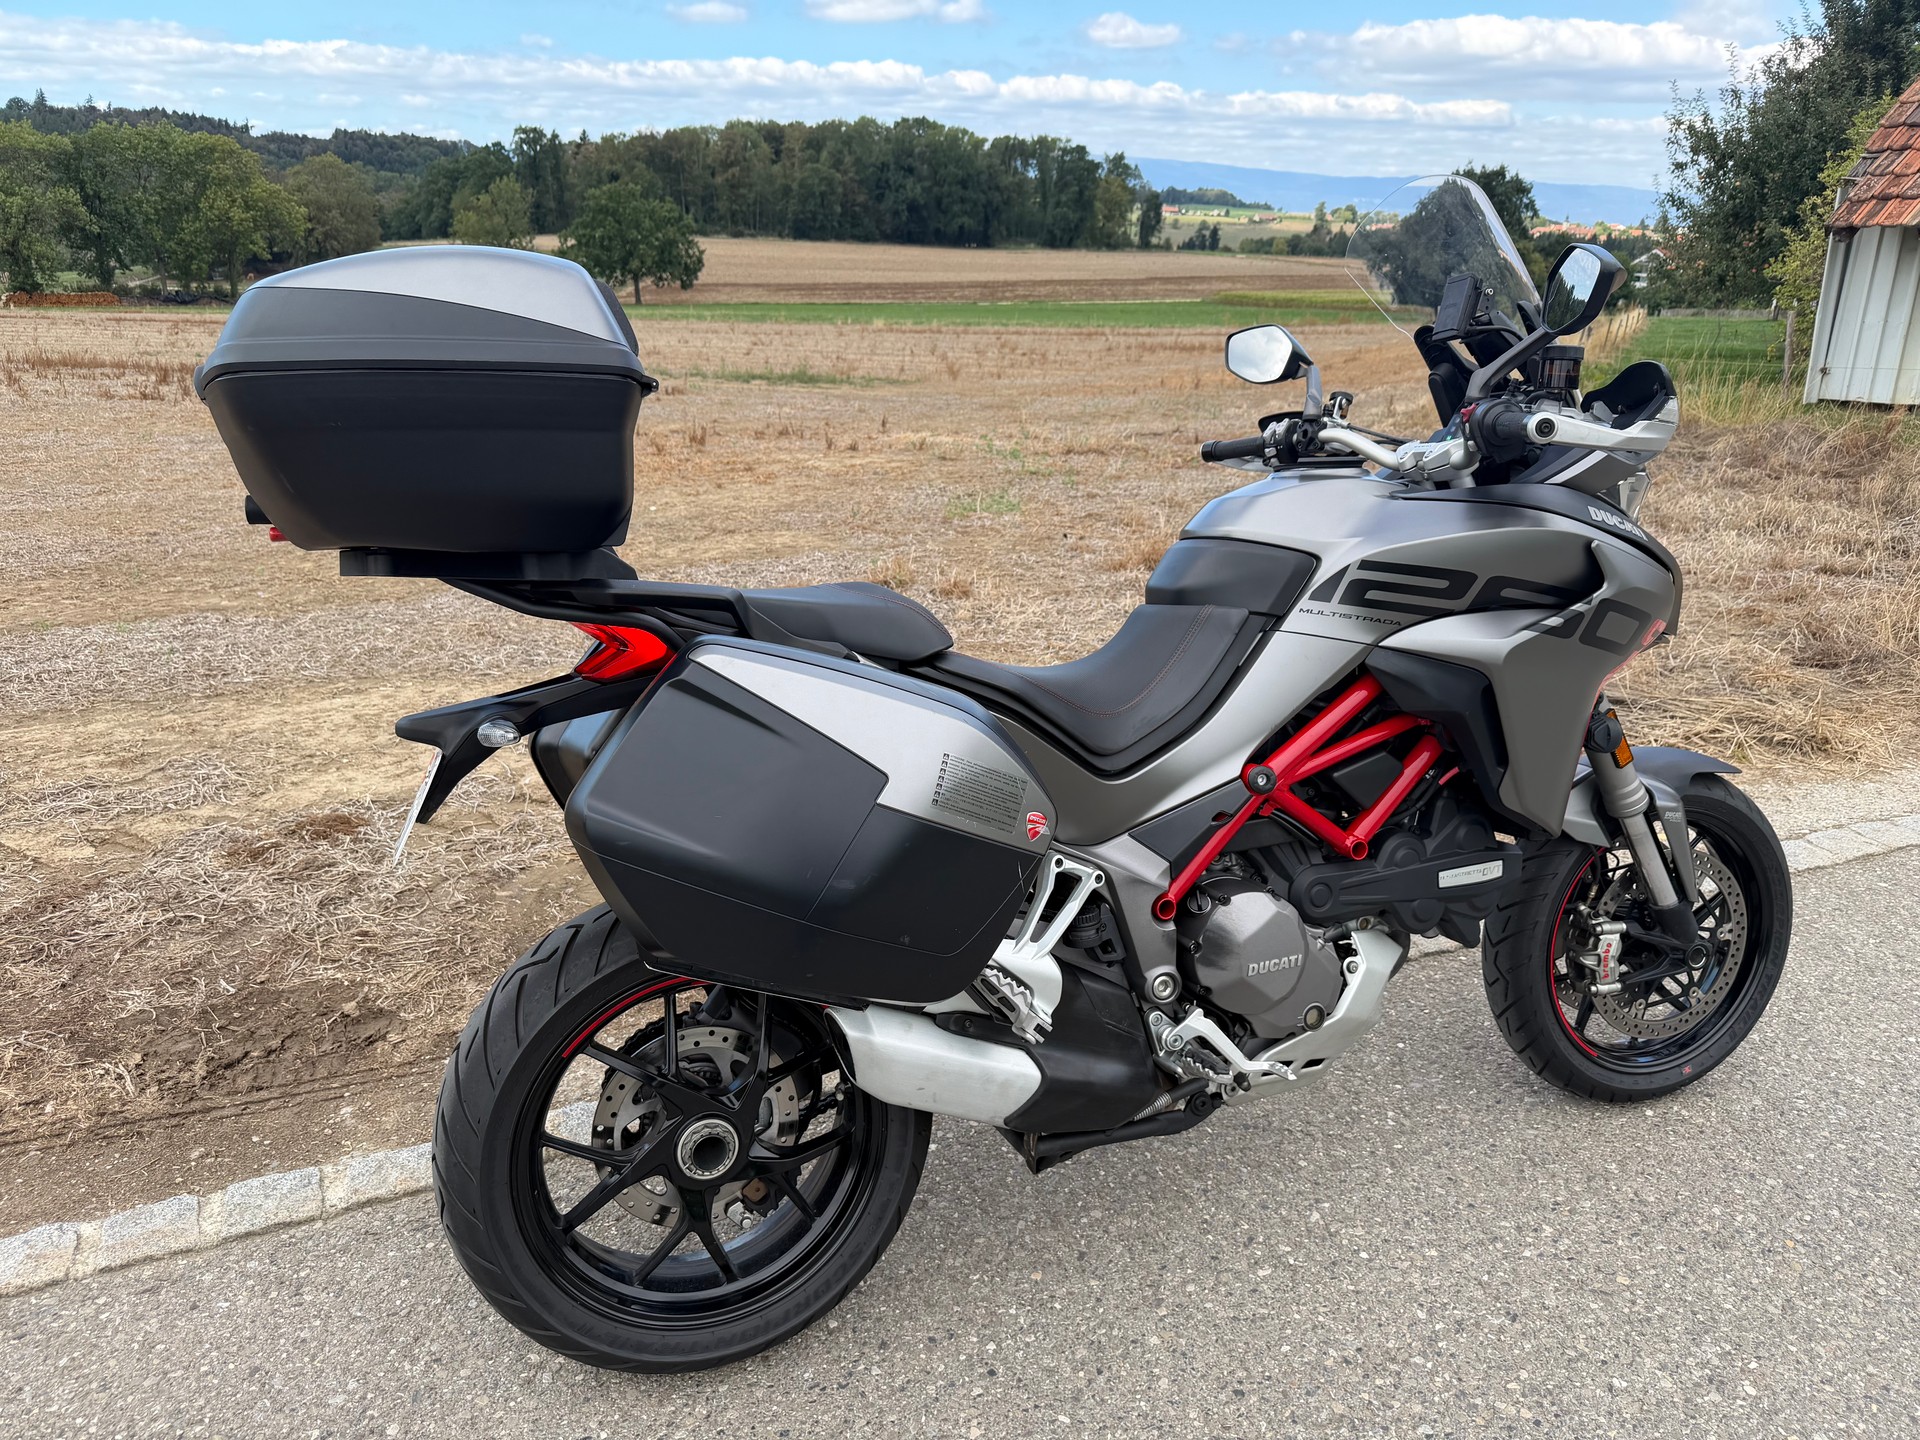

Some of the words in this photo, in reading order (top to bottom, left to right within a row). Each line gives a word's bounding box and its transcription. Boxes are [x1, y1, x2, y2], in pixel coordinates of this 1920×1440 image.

[1587, 505, 1649, 542] DUCATI
[1298, 608, 1402, 627] MULTISTRADA
[1247, 954, 1302, 977] DUCATI
[1601, 942, 1613, 980] brembo
